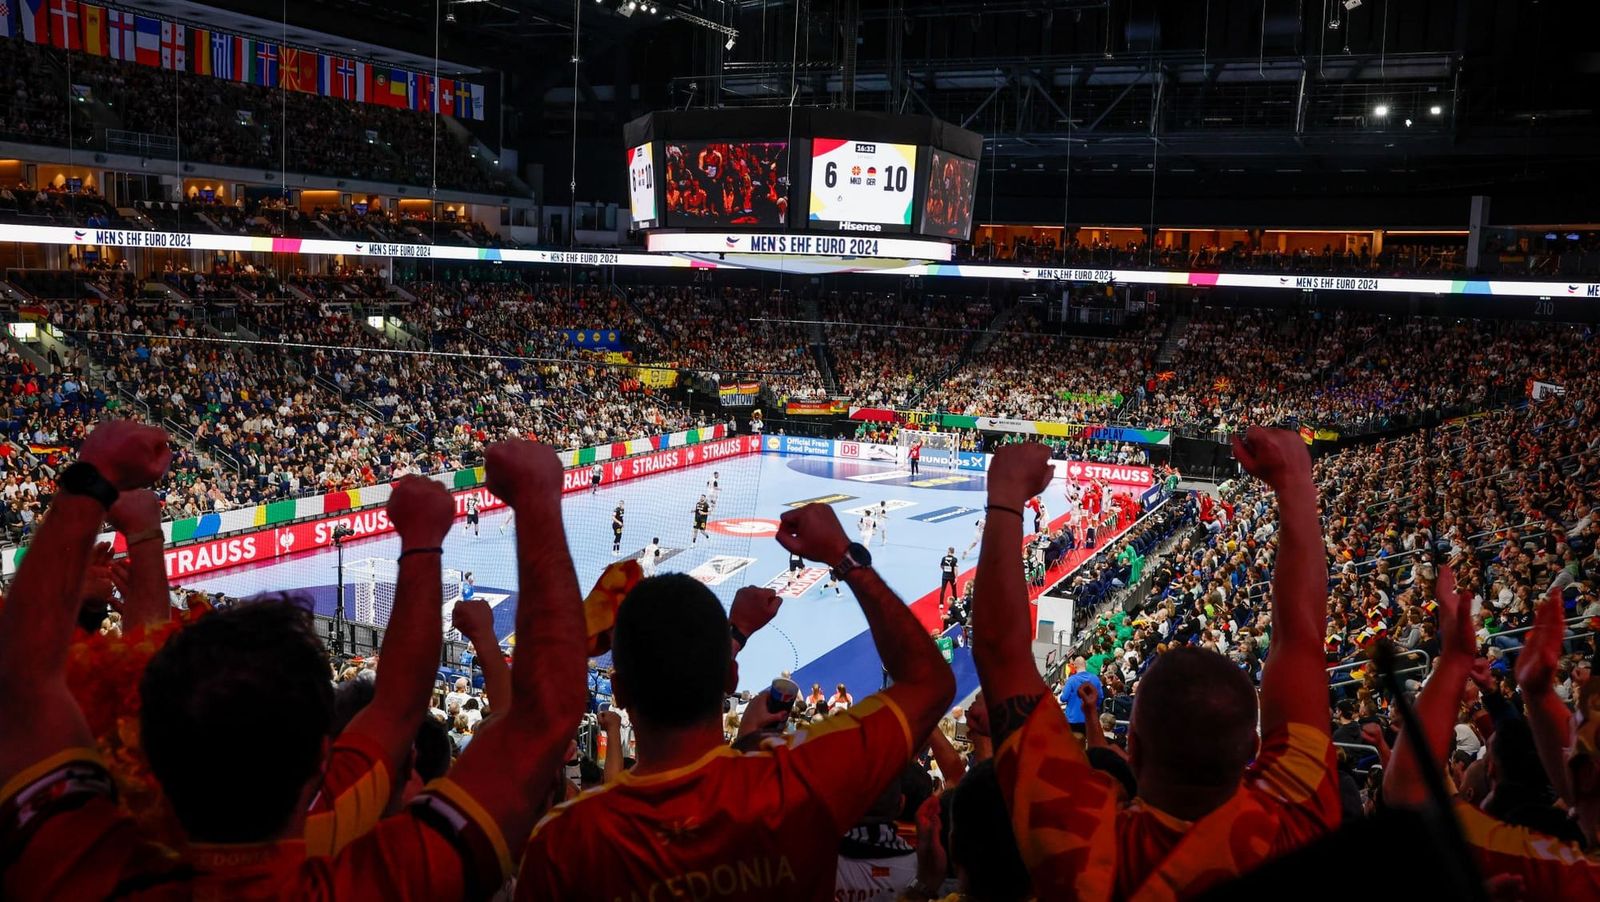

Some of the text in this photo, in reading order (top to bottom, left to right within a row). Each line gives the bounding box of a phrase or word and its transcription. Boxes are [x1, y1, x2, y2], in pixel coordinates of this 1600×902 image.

[825, 162, 837, 188] 6
[850, 177, 862, 185] MKD
[866, 178, 877, 186] GER
[884, 166, 908, 192] 10
[839, 221, 882, 232] Hisense
[126, 232, 142, 246] EHF
[144, 232, 167, 247] EURO
[169, 234, 192, 247] 2024
[790, 236, 812, 253] EHF
[816, 238, 846, 254] EURO
[850, 239, 879, 256] 2024
[388, 244, 399, 256] EHF
[400, 244, 415, 257] EURO
[416, 245, 431, 257] 2024
[566, 253, 578, 263] EHF
[580, 254, 598, 263] EURO
[600, 254, 618, 264] 2024
[1060, 270, 1072, 279] EHF
[1074, 270, 1093, 280] EURO
[1094, 271, 1113, 281] 2024
[1320, 278, 1334, 288] EHF
[1336, 279, 1356, 289] EURO
[1358, 280, 1378, 290] 2024
[1534, 301, 1554, 316] 210
[721, 394, 754, 406] GUMTOW
[894, 410, 945, 424] HERE TO PLAY
[1067, 425, 1124, 440] HERE TO PLAY
[702, 438, 741, 459] STRAUSS
[786, 438, 811, 446] Official
[812, 439, 830, 448] Fresh
[786, 445, 829, 455] Food Partner
[843, 444, 858, 455] DB
[632, 452, 679, 474] STRAUSS
[1084, 467, 1150, 483] STRAUSS
[314, 510, 395, 544] STRAUS
[164, 537, 256, 576] TRAUSS
